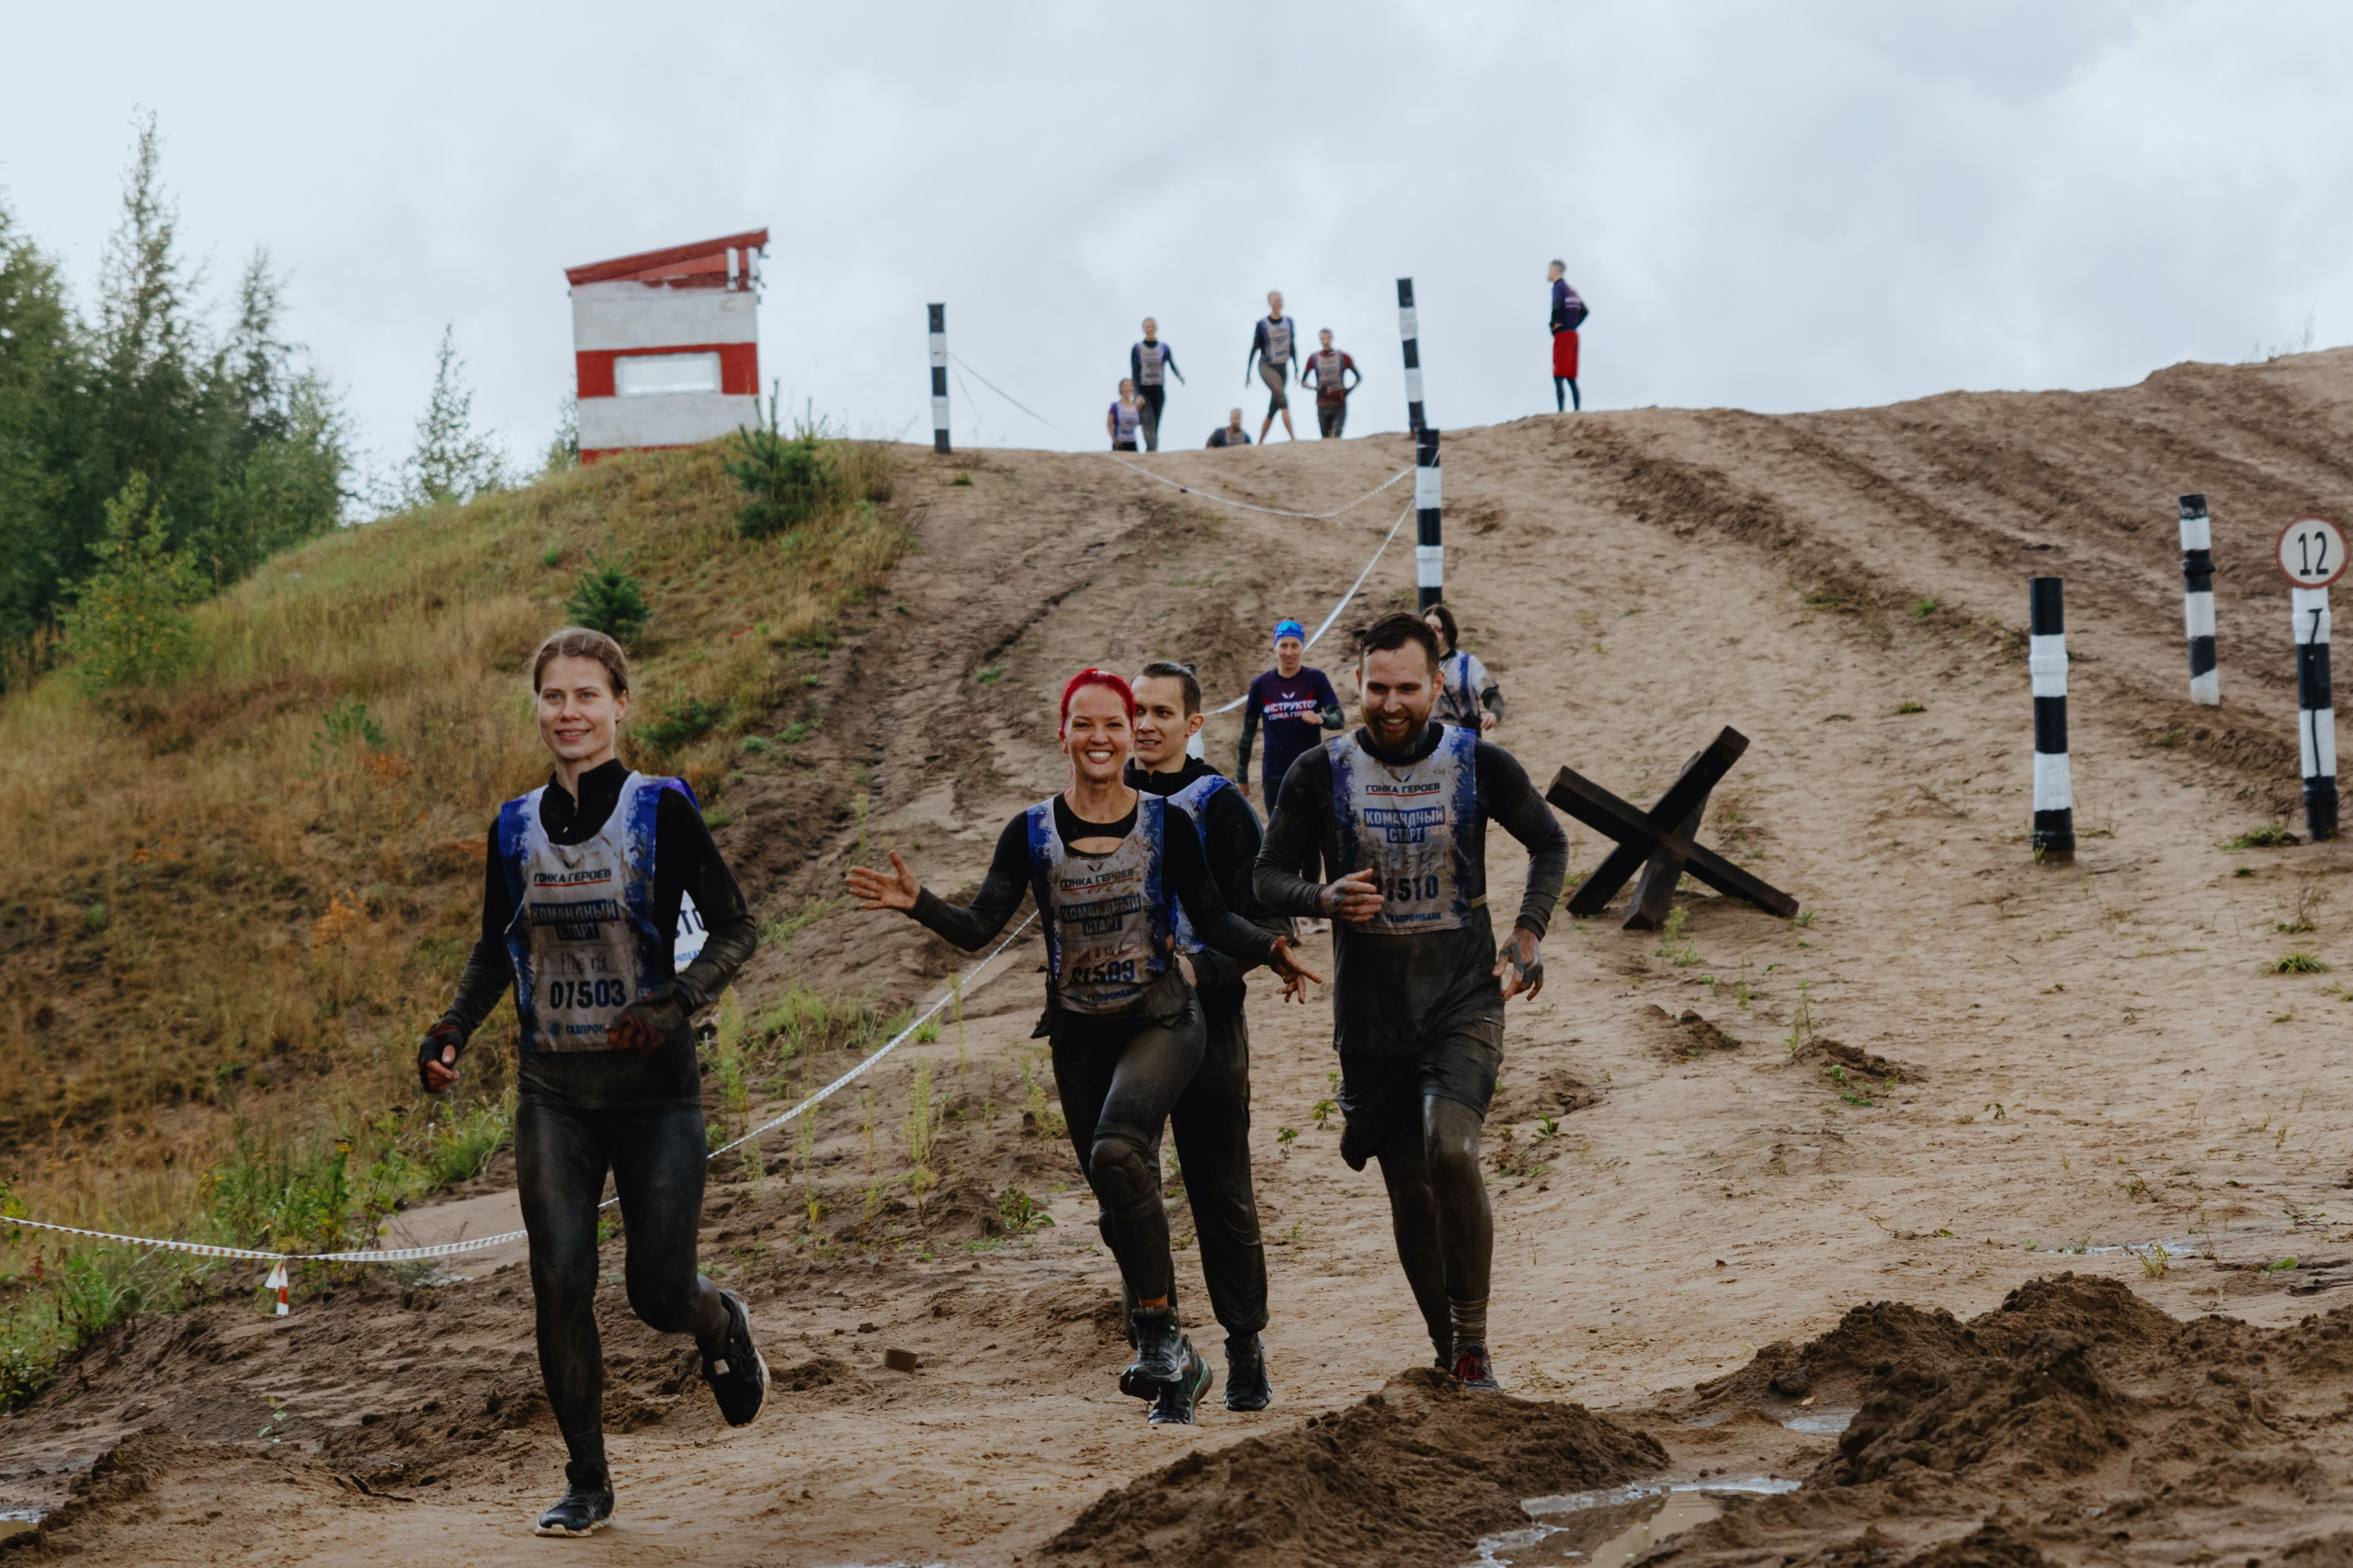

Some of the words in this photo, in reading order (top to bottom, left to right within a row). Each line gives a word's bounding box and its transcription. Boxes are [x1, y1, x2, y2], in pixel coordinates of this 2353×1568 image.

[2298, 530, 2329, 576] 12
[1290, 710, 1306, 719] ГЕР
[1365, 784, 1399, 794] ГОНКА
[1402, 782, 1440, 794] ГЕРОЕВ
[1365, 806, 1444, 828] КОМАНДНЫЙ
[1389, 827, 1423, 842] СТАРТ
[534, 871, 566, 883] ГОНКА
[569, 869, 612, 882] ГЕРОЕВ
[1060, 877, 1093, 888] ГОНКА
[1096, 869, 1134, 884] ГЕРОЕВ
[1386, 912, 1442, 923] ГАЗПРОМБАНК
[550, 979, 627, 1010] 01503
